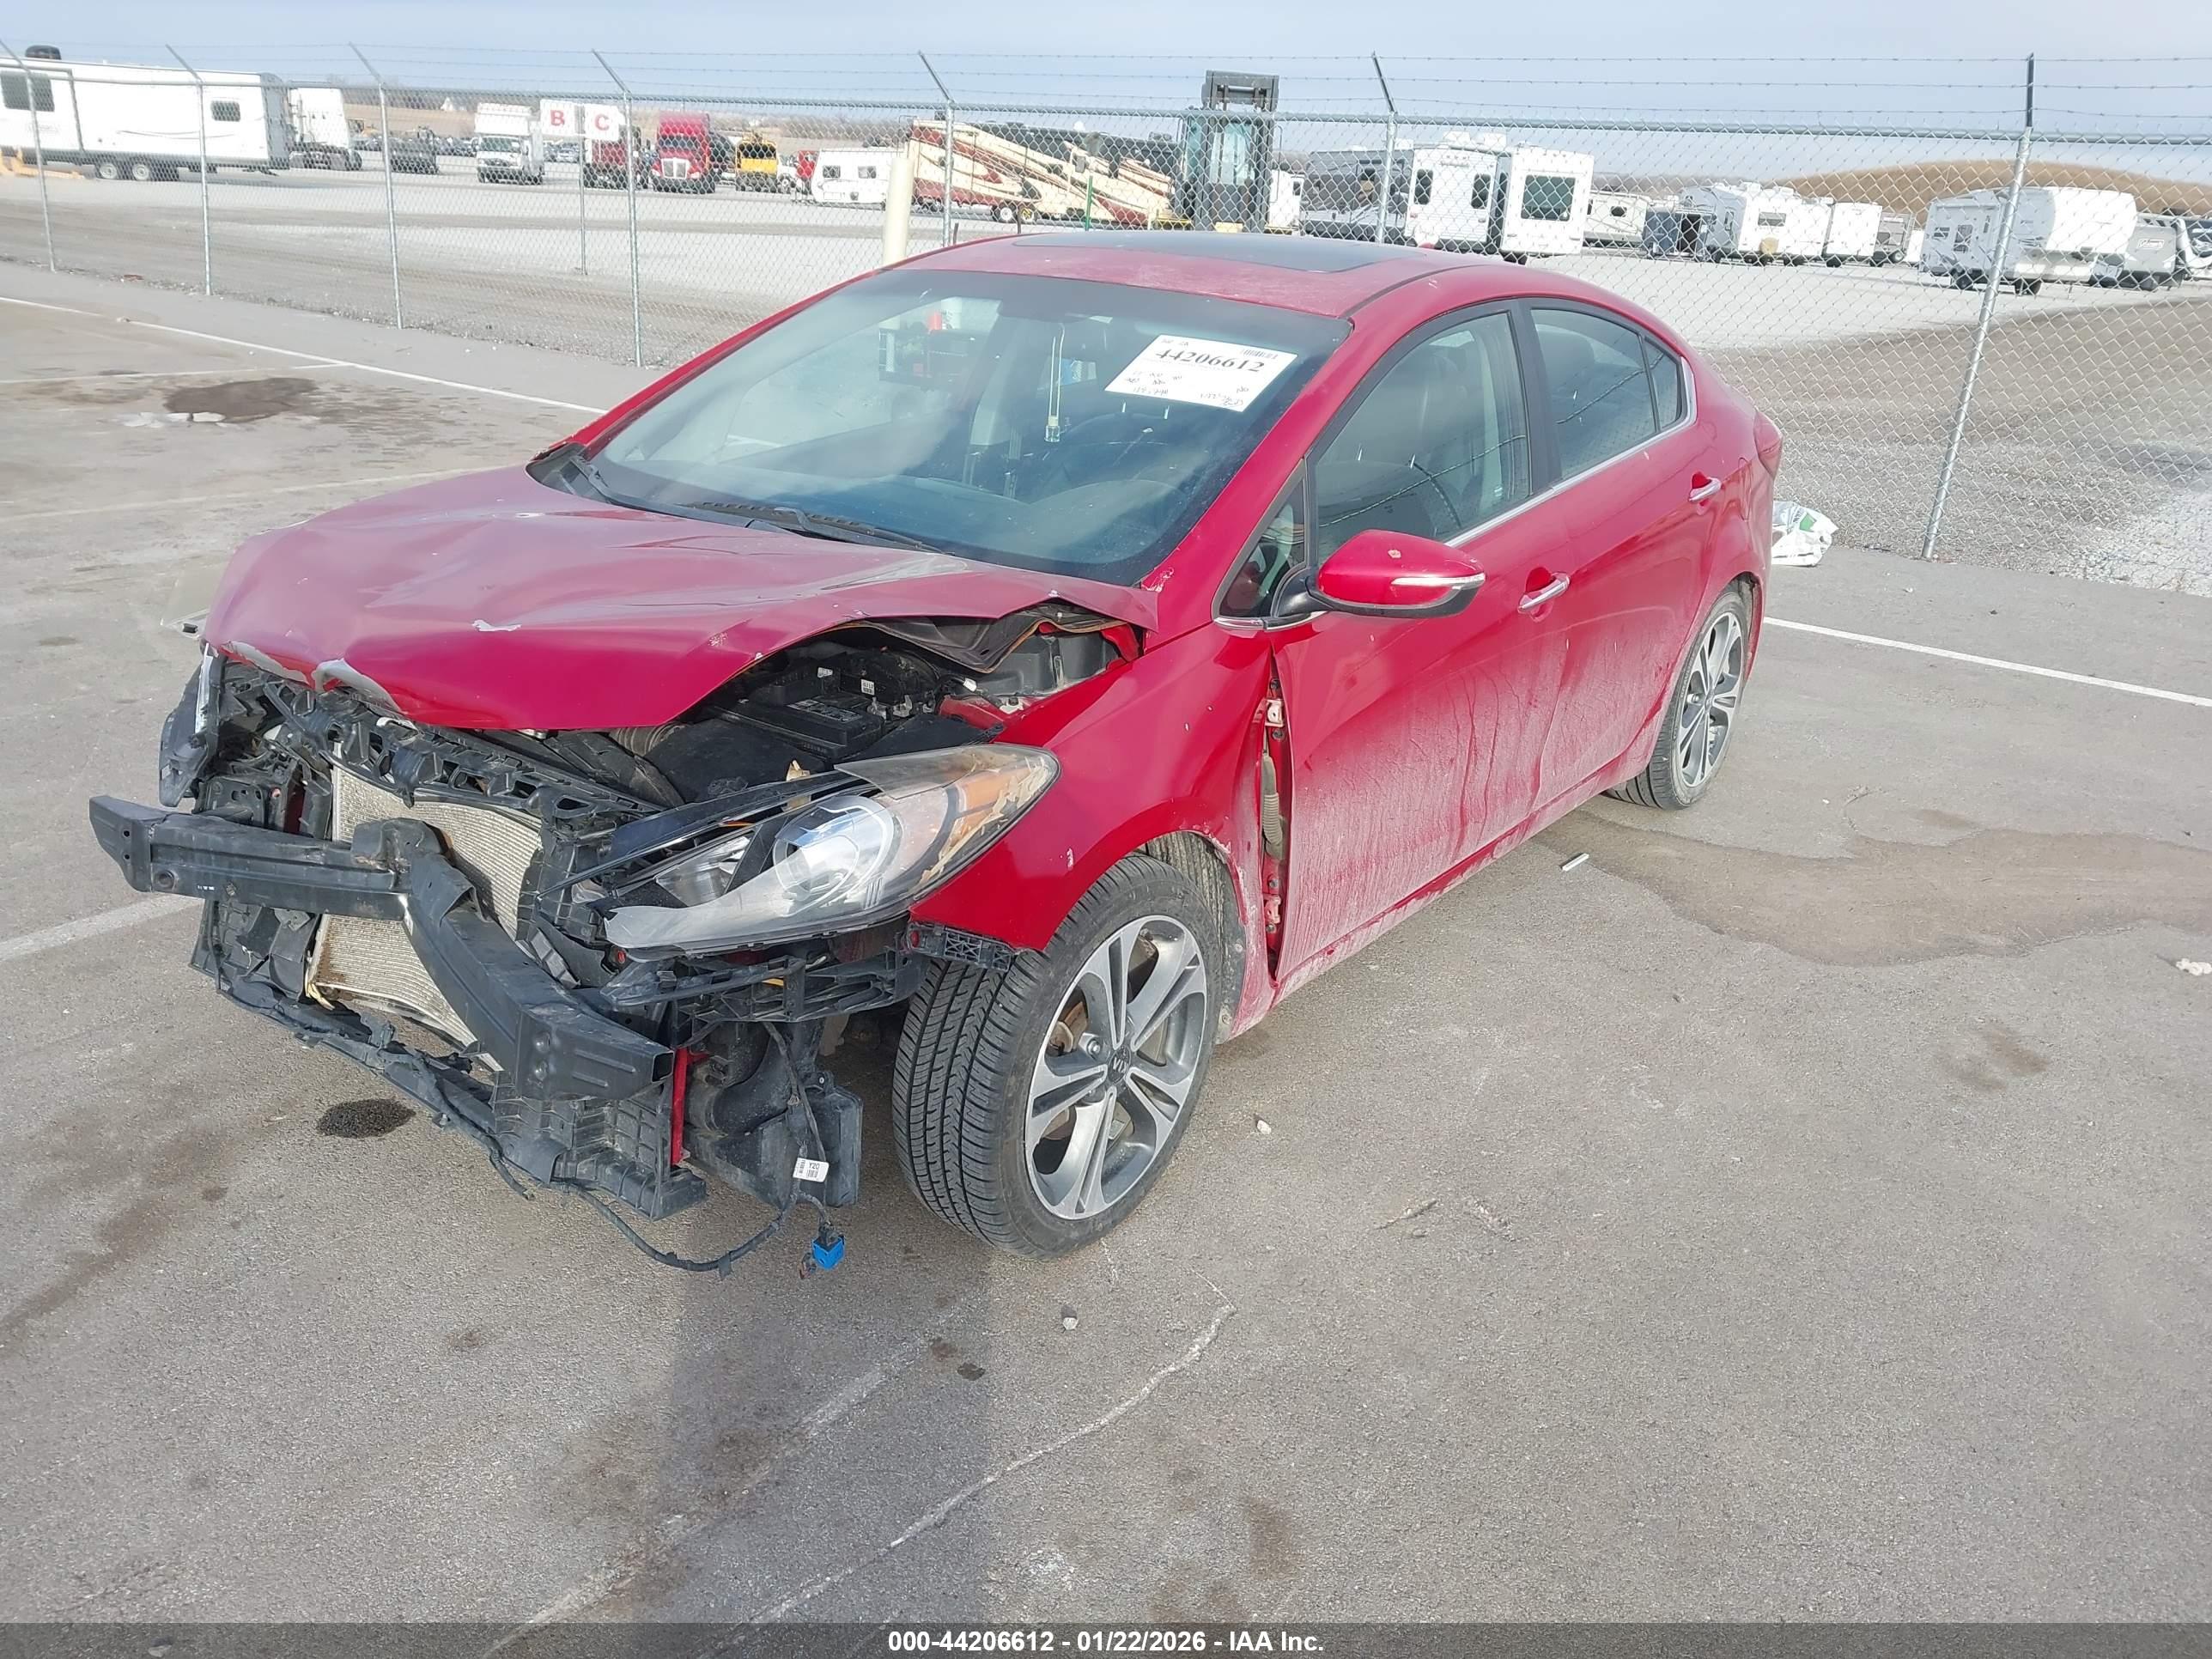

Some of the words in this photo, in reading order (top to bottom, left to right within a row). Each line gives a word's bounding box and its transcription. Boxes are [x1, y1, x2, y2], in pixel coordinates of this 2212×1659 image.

[550, 110, 565, 126] B
[594, 113, 610, 131] C
[1156, 349, 1265, 373] 44206612
